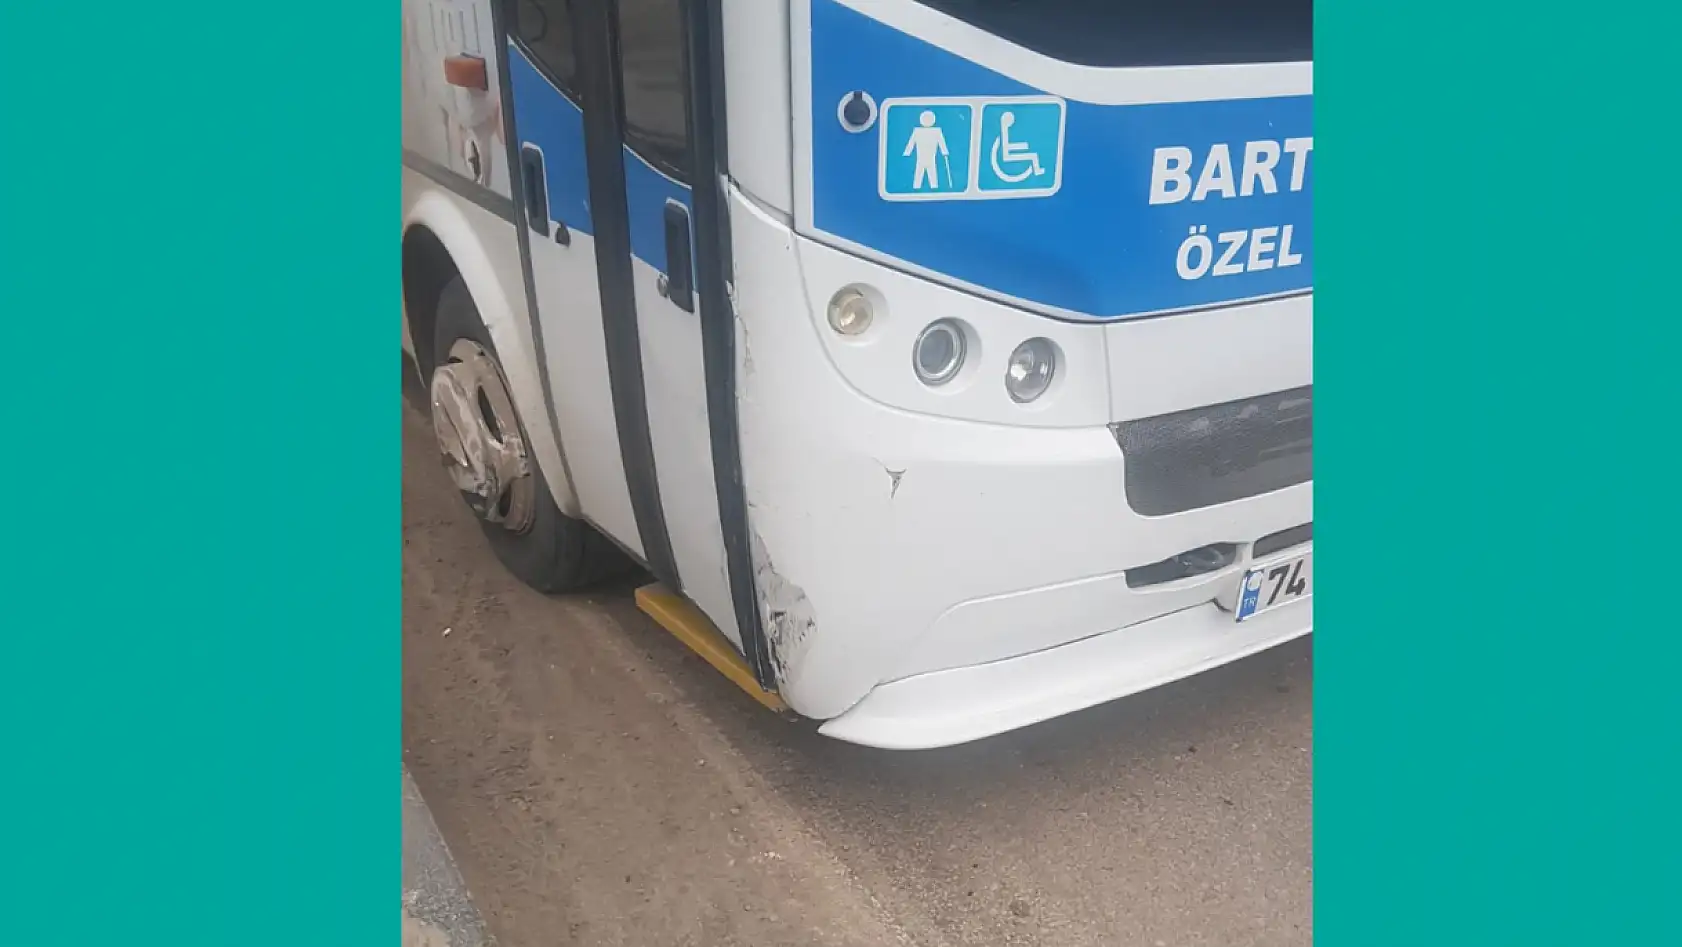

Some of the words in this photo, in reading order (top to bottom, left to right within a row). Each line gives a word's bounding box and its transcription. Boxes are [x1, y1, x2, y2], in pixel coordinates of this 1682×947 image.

[1149, 137, 1313, 205] BART
[1176, 224, 1303, 280] ÖZEL
[1243, 597, 1257, 608] TR
[1267, 559, 1306, 606] 74
